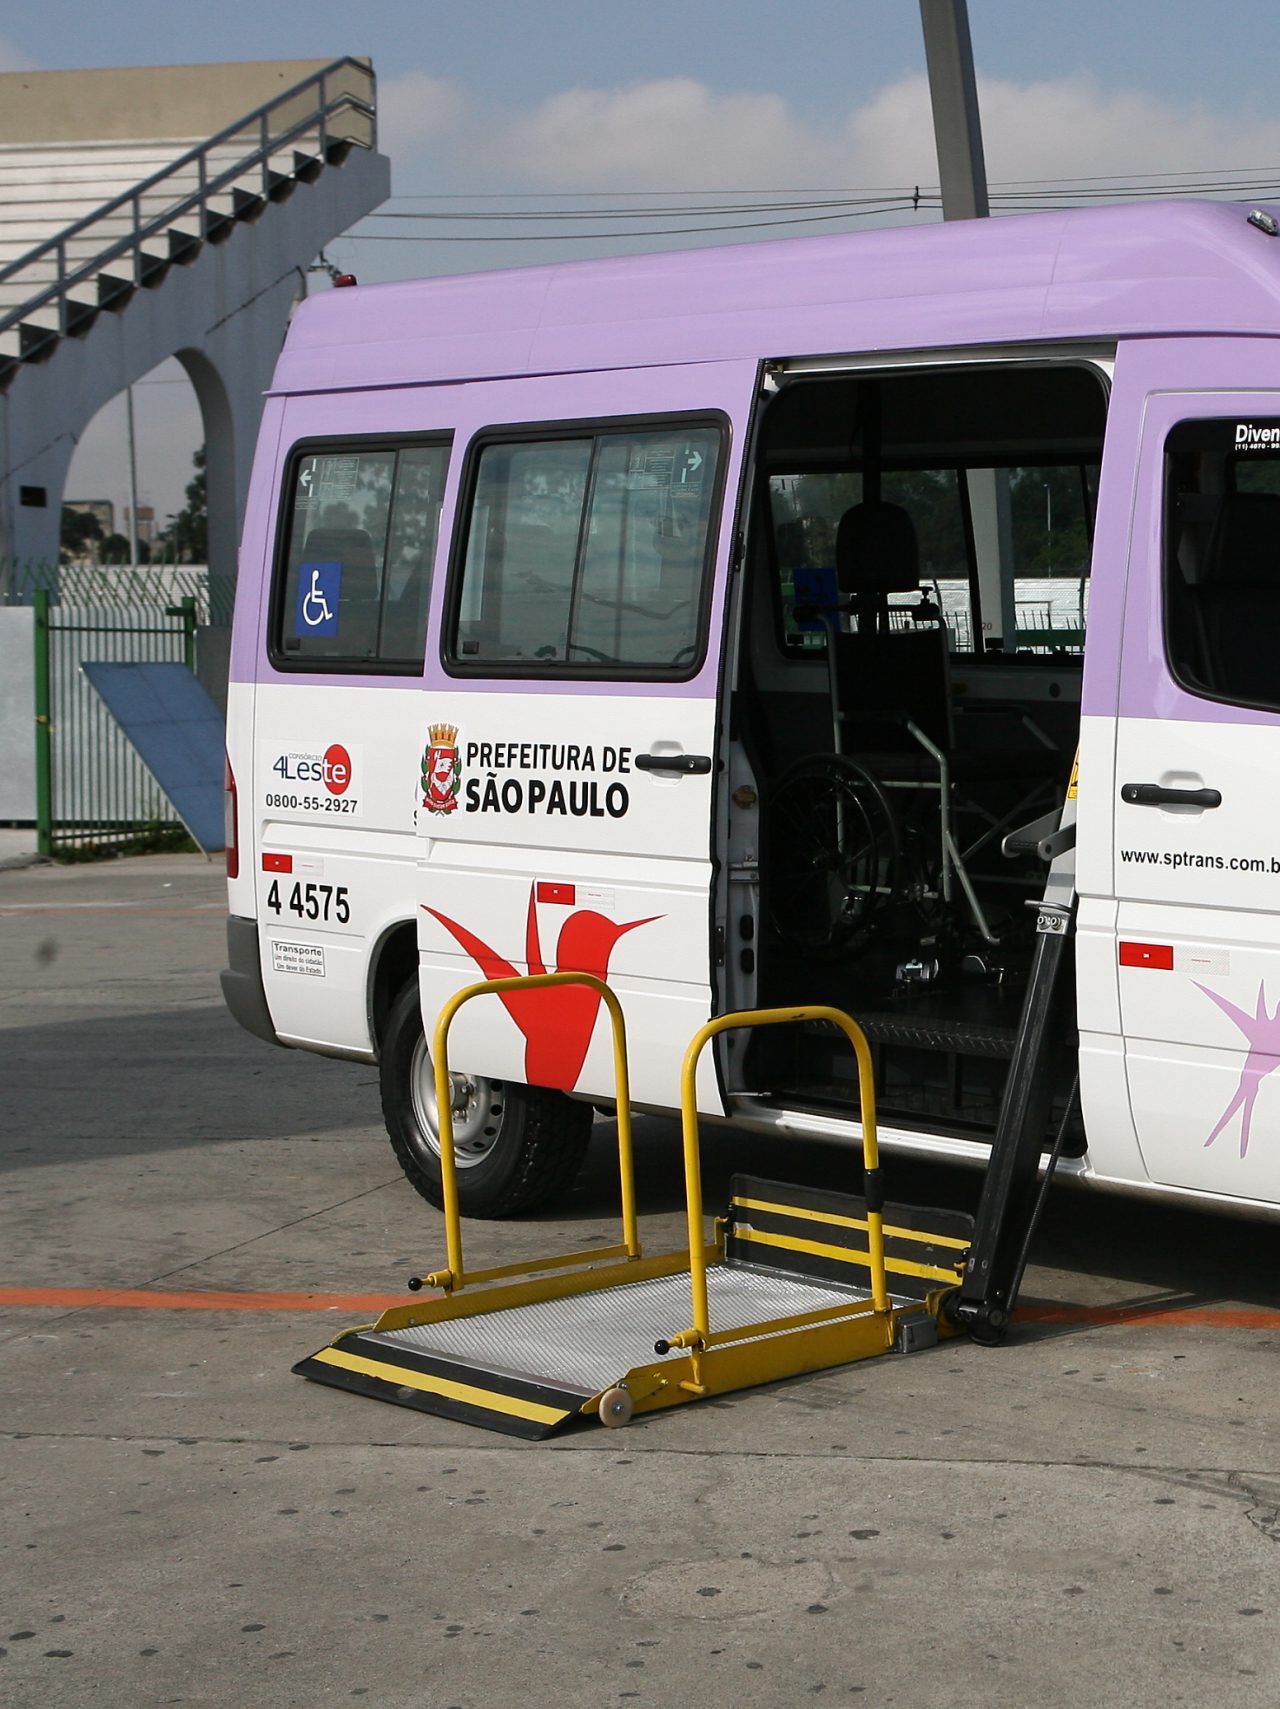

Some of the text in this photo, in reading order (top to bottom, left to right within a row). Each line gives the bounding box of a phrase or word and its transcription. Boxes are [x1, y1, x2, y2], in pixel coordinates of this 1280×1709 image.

[1234, 443, 1248, 451] (11)
[466, 742, 632, 774] PREFEITURA DE
[265, 793, 358, 814] 0800-55-2927
[465, 771, 629, 818] SÃO PAULO
[267, 879, 350, 924] 4 4575
[274, 943, 322, 957] Transporte
